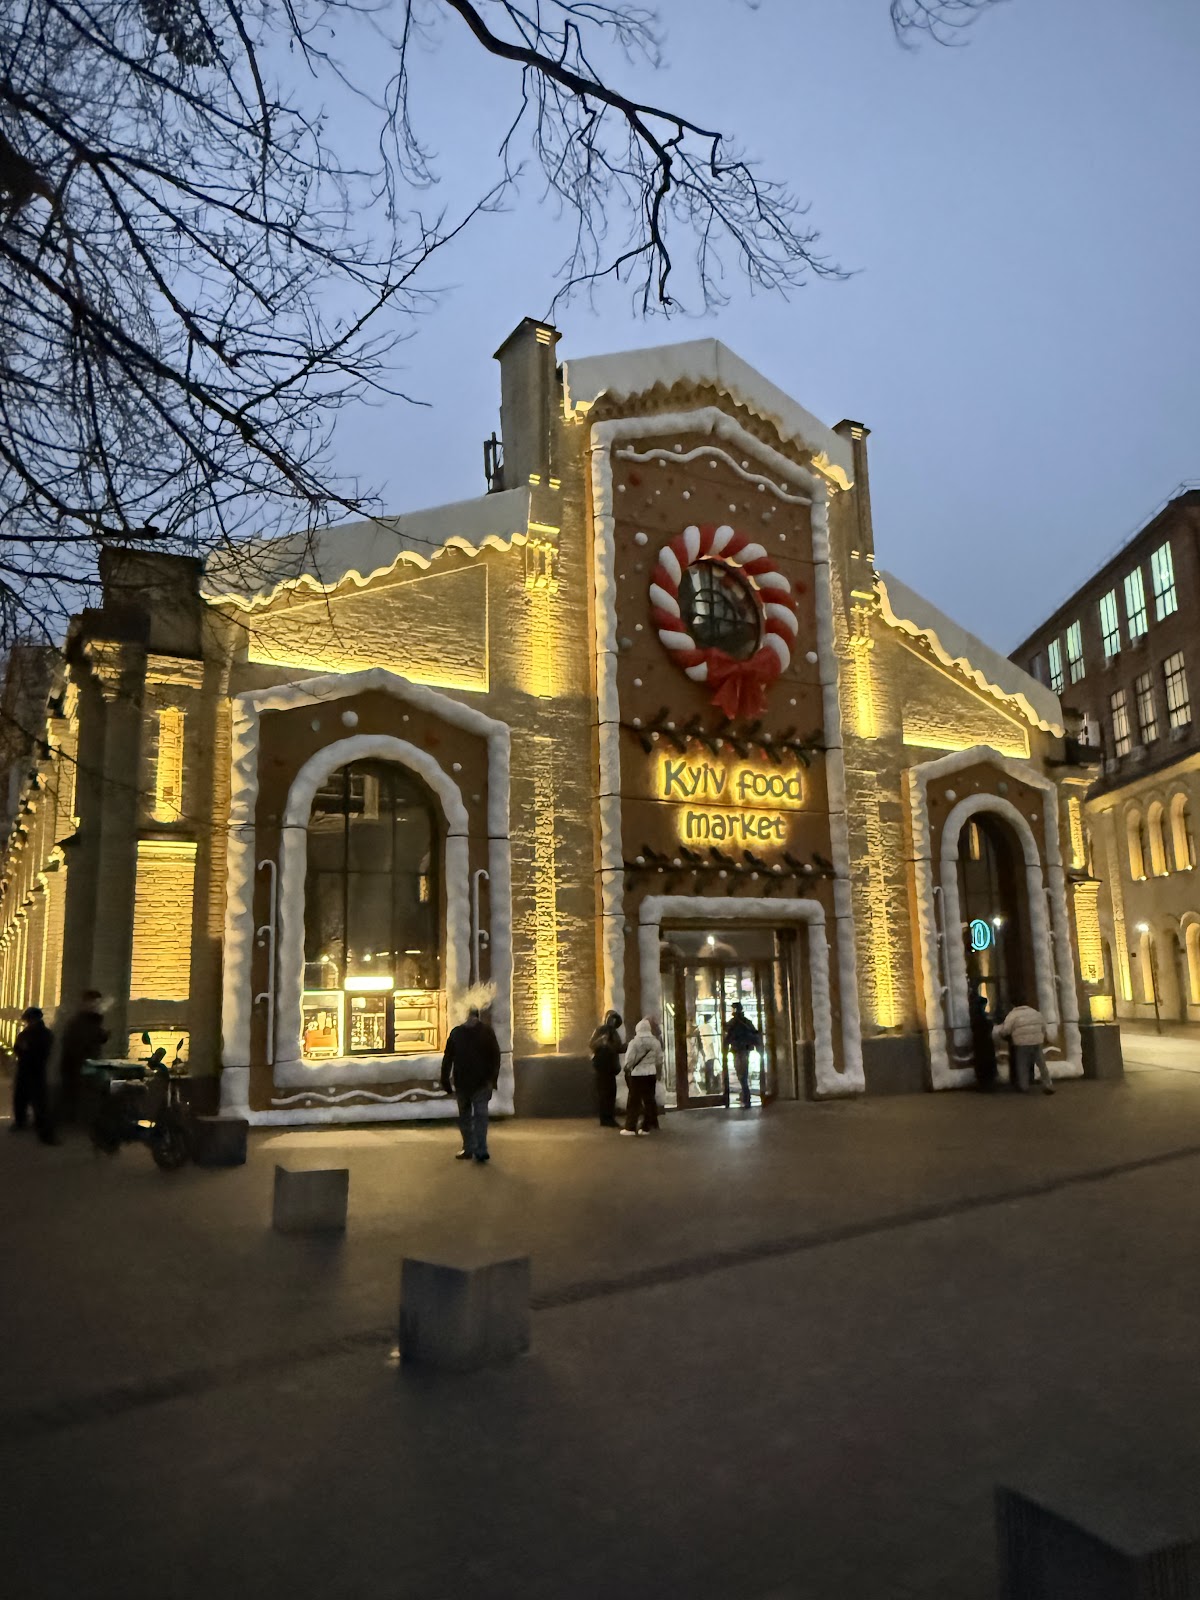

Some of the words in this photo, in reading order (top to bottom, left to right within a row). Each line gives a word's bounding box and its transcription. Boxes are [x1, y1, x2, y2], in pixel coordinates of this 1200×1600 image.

[664, 759, 726, 796] Kyiv
[736, 769, 803, 800] food
[687, 810, 787, 840] market
